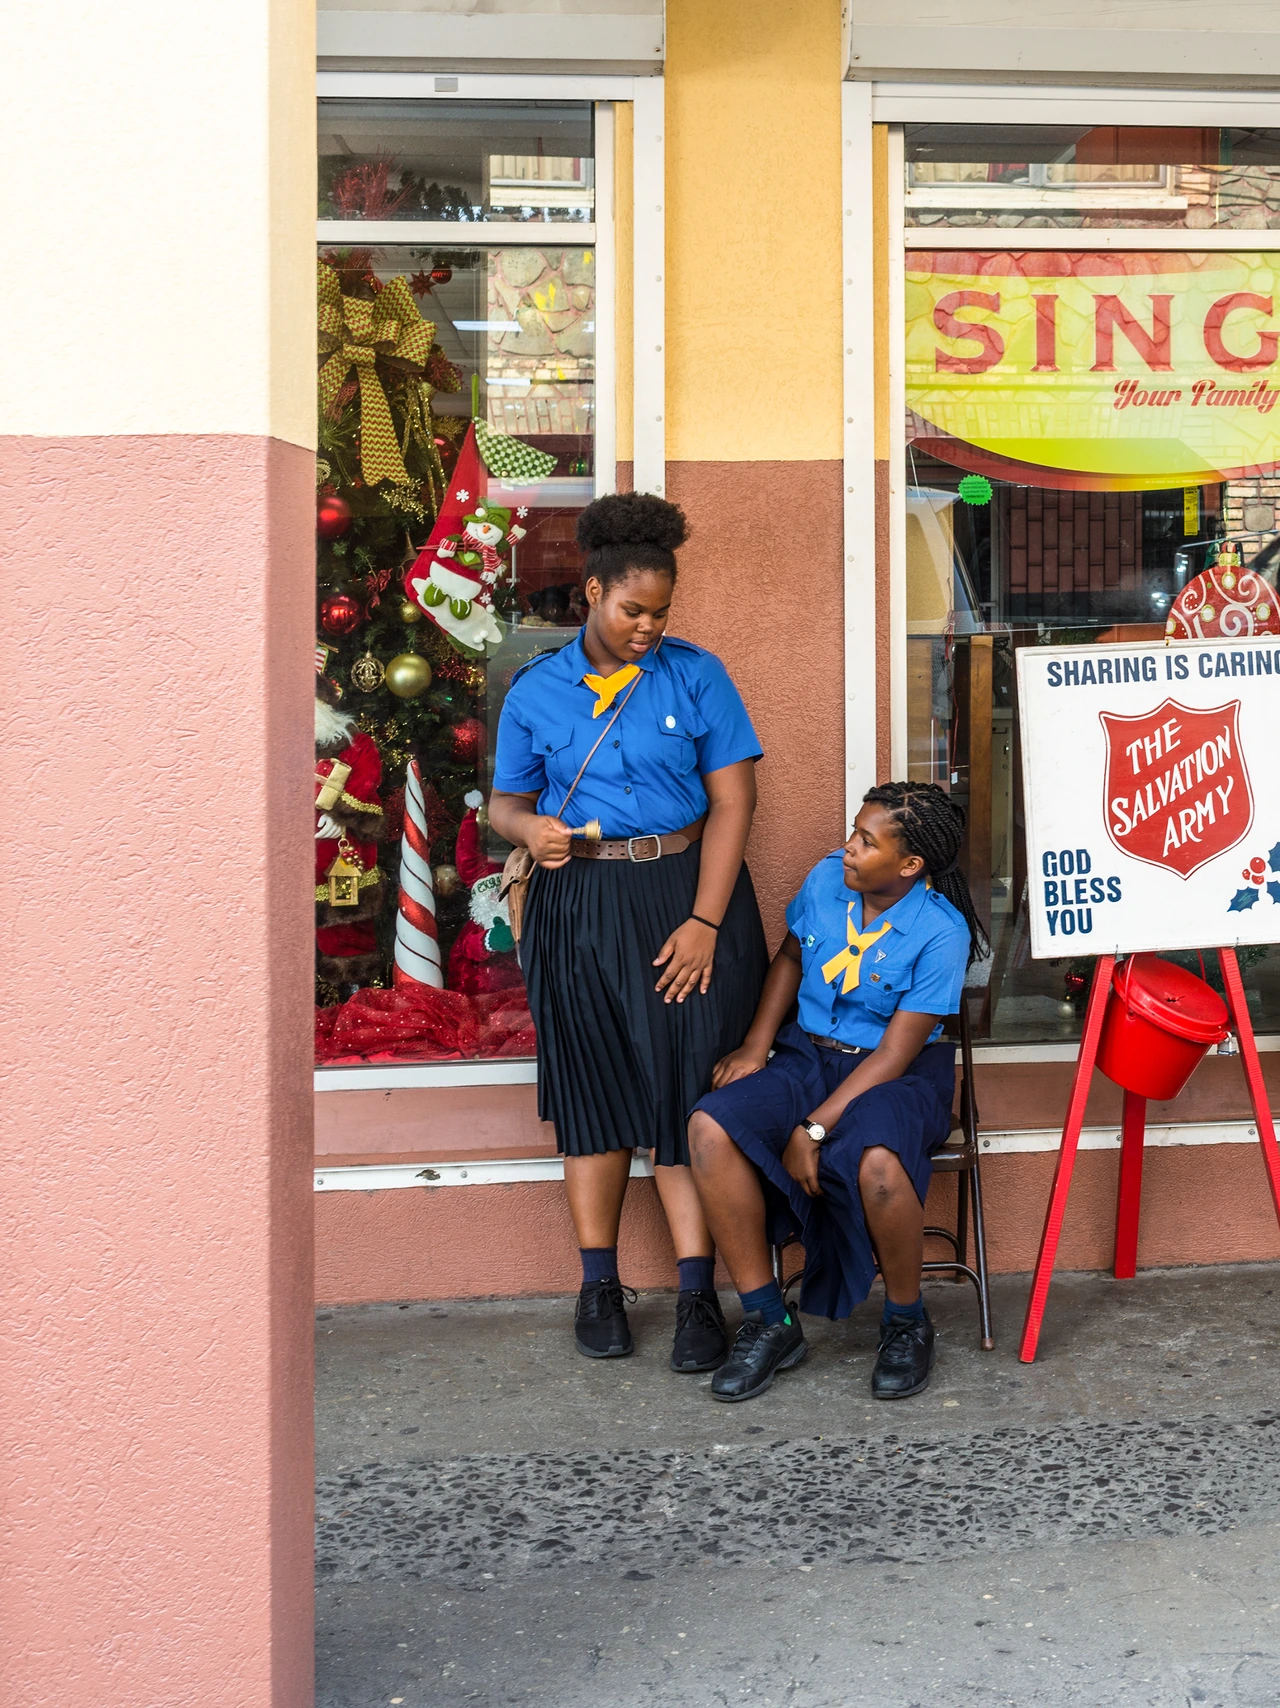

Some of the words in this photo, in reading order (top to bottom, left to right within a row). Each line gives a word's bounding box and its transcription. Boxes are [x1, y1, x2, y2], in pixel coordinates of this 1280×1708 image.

[1113, 379, 1182, 410] Your
[1190, 379, 1280, 414] Family
[1047, 656, 1157, 687] SHARING
[1165, 654, 1189, 680] IS
[1126, 718, 1183, 775] THE
[1111, 725, 1232, 836] SALVATION
[1162, 775, 1234, 858] ARMY
[1042, 849, 1091, 877] GOD
[1044, 876, 1122, 907] BLESS
[1046, 908, 1093, 936] YOU
